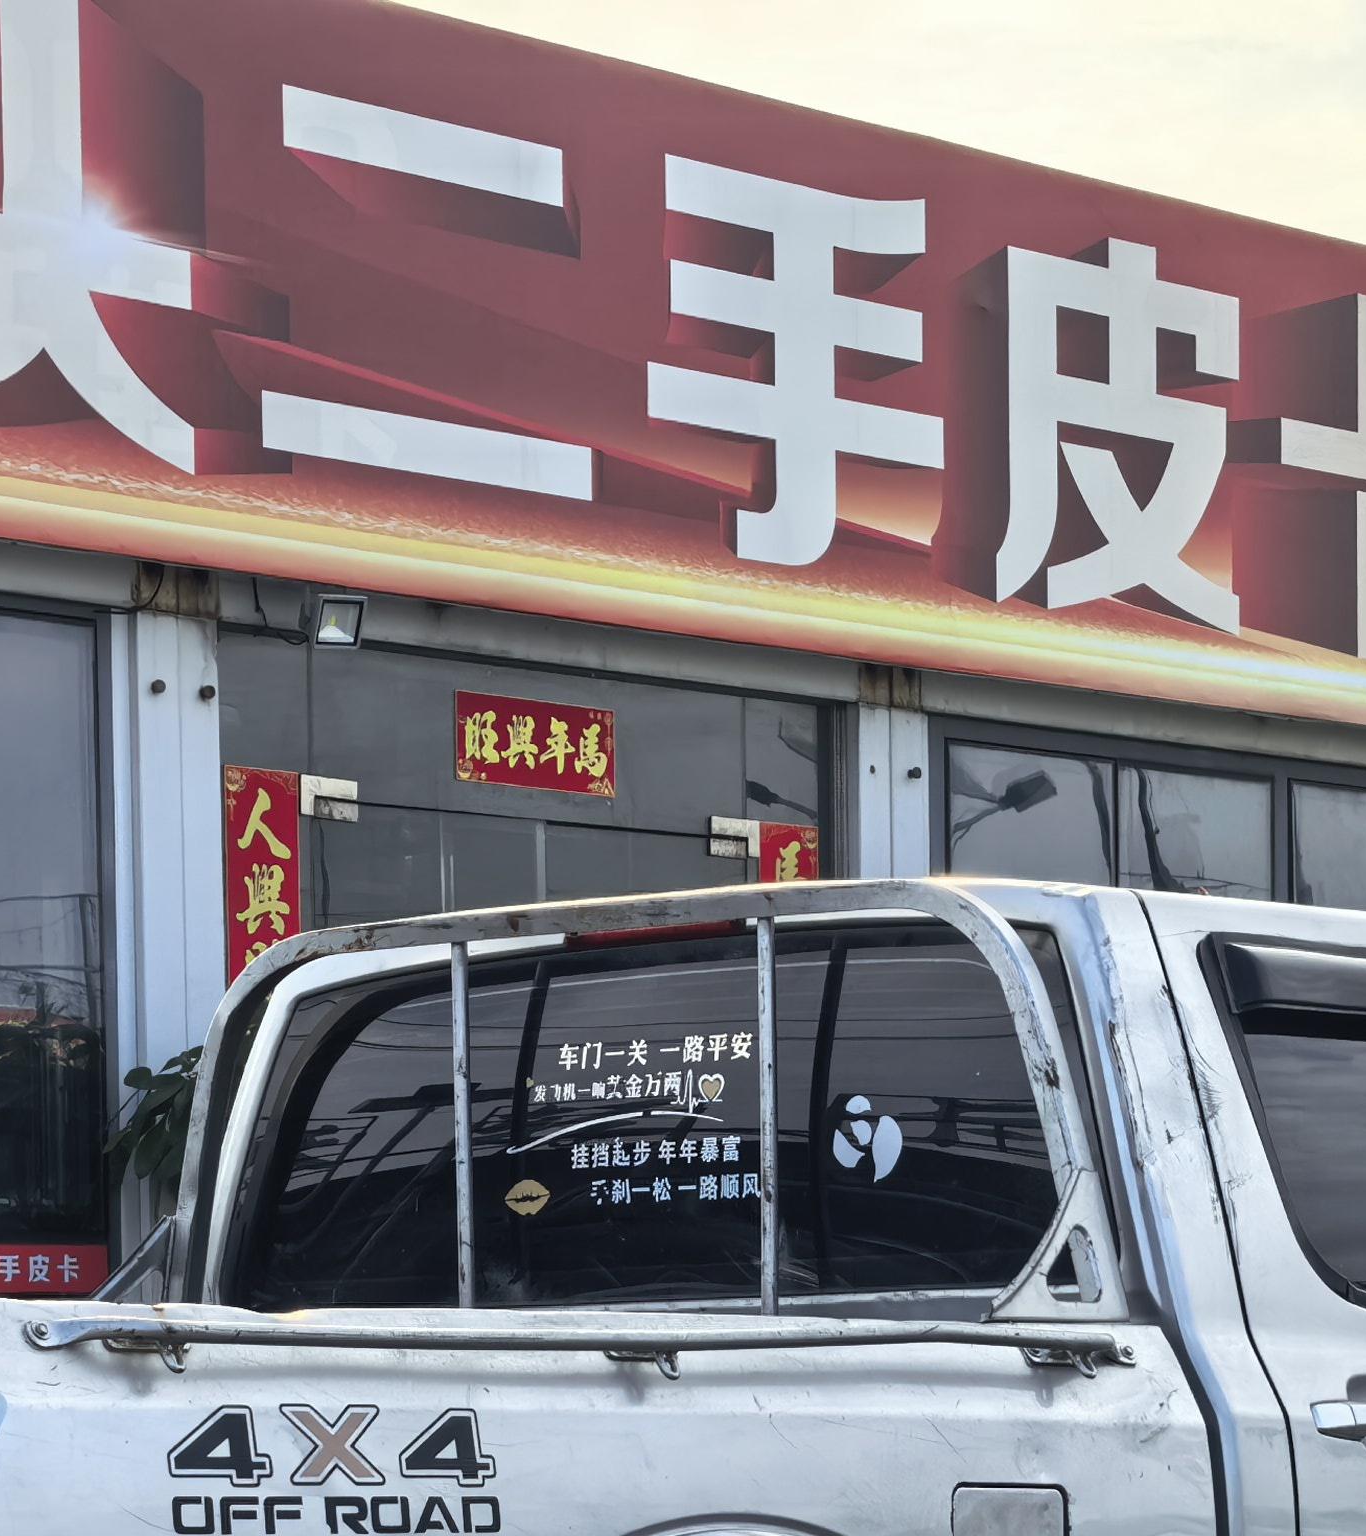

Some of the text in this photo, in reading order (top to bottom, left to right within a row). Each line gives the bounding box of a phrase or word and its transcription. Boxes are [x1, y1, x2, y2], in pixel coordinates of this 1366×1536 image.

[558, 1032, 754, 1071] 车门一关 一路平安
[658, 1135, 742, 1165] 年年暴富
[678, 1173, 762, 1202] 一路顺风
[167, 1403, 496, 1488] 4X4
[171, 1496, 501, 1535] OFF ROAD
